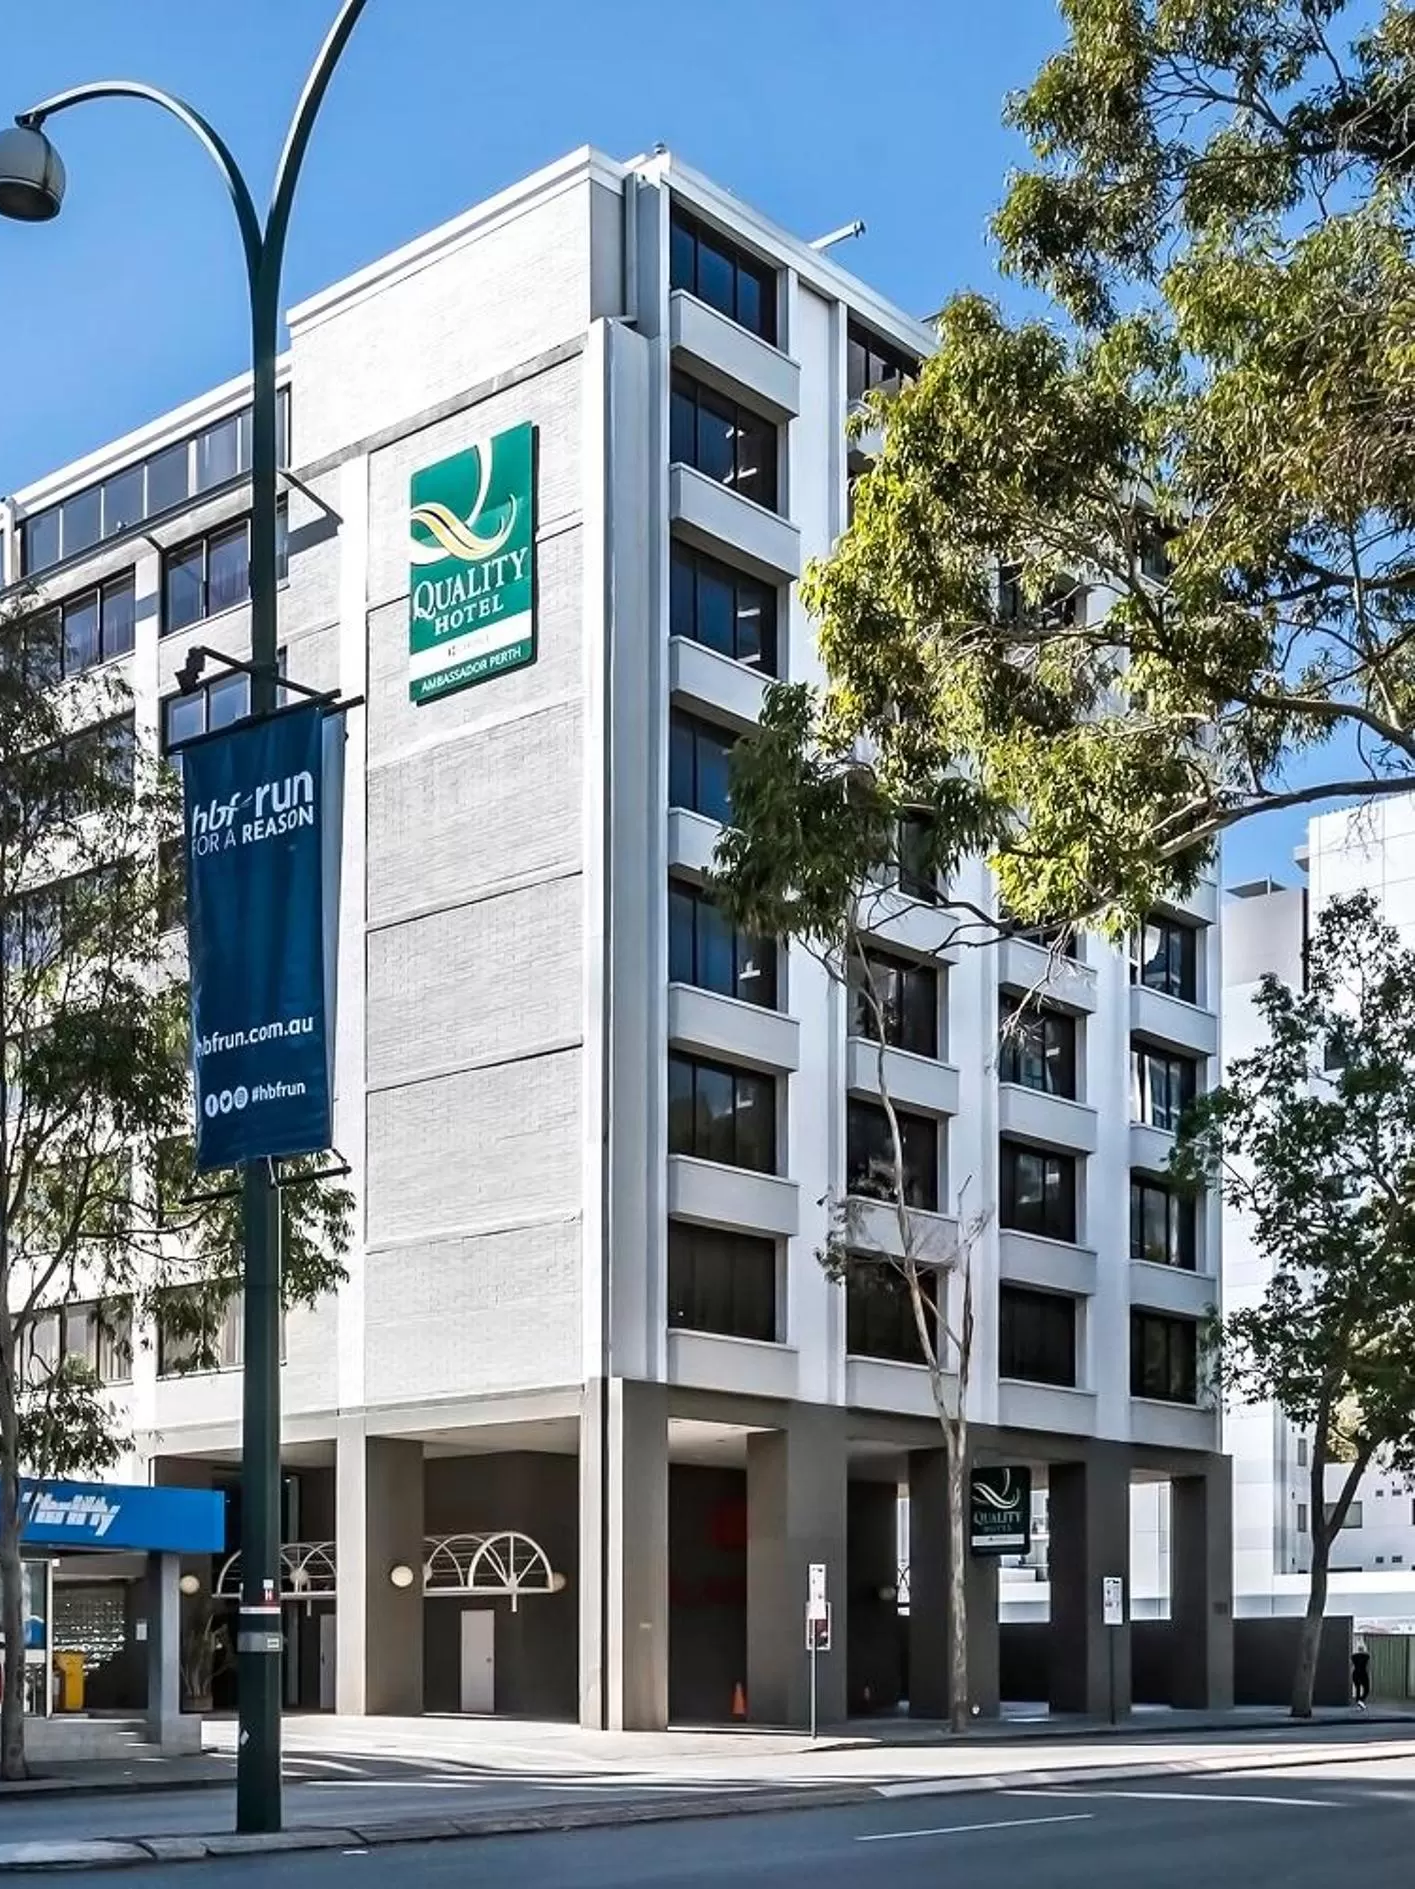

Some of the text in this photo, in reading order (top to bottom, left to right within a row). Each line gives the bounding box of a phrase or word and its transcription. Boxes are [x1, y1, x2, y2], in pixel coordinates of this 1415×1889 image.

[414, 547, 528, 620] QUALITY
[434, 594, 504, 636] HOTEL
[421, 659, 488, 693] AMBASSADOR
[489, 645, 522, 668] PERTH
[192, 770, 314, 837] hbf run
[223, 828, 236, 850] A
[242, 805, 314, 844] REASON
[252, 1080, 306, 1102] #hbfrun
[974, 1511, 1023, 1526] QUALITY
